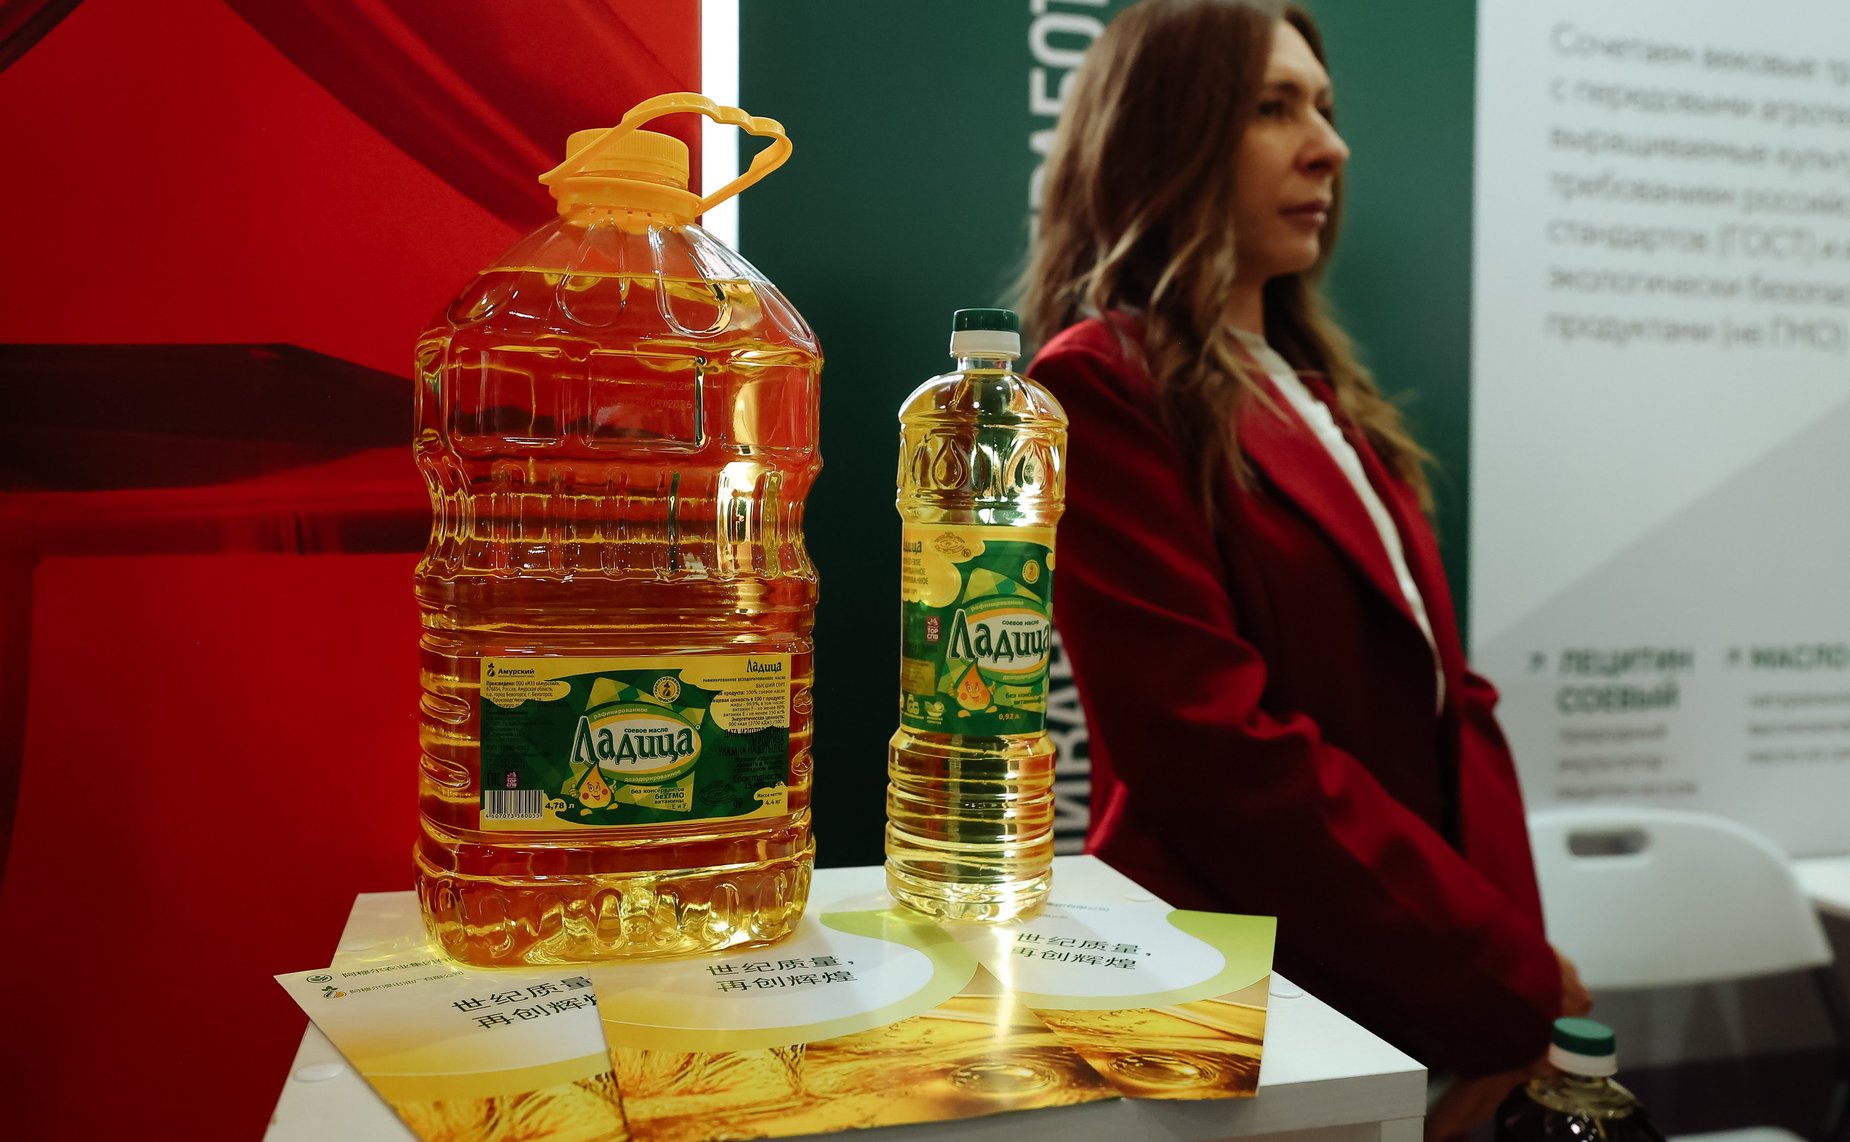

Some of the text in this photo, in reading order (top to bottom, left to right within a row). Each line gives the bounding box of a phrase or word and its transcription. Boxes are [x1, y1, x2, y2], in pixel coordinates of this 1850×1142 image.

[498, 667, 535, 676] Амурский
[746, 658, 782, 674] Ладица
[593, 707, 648, 720] рафинированное
[998, 713, 1014, 721] 0,92
[572, 716, 695, 766] Ладица
[545, 802, 565, 810] 4,78
[1010, 946, 1137, 970] 再创辉煌
[716, 971, 858, 992] 再创辉煌
